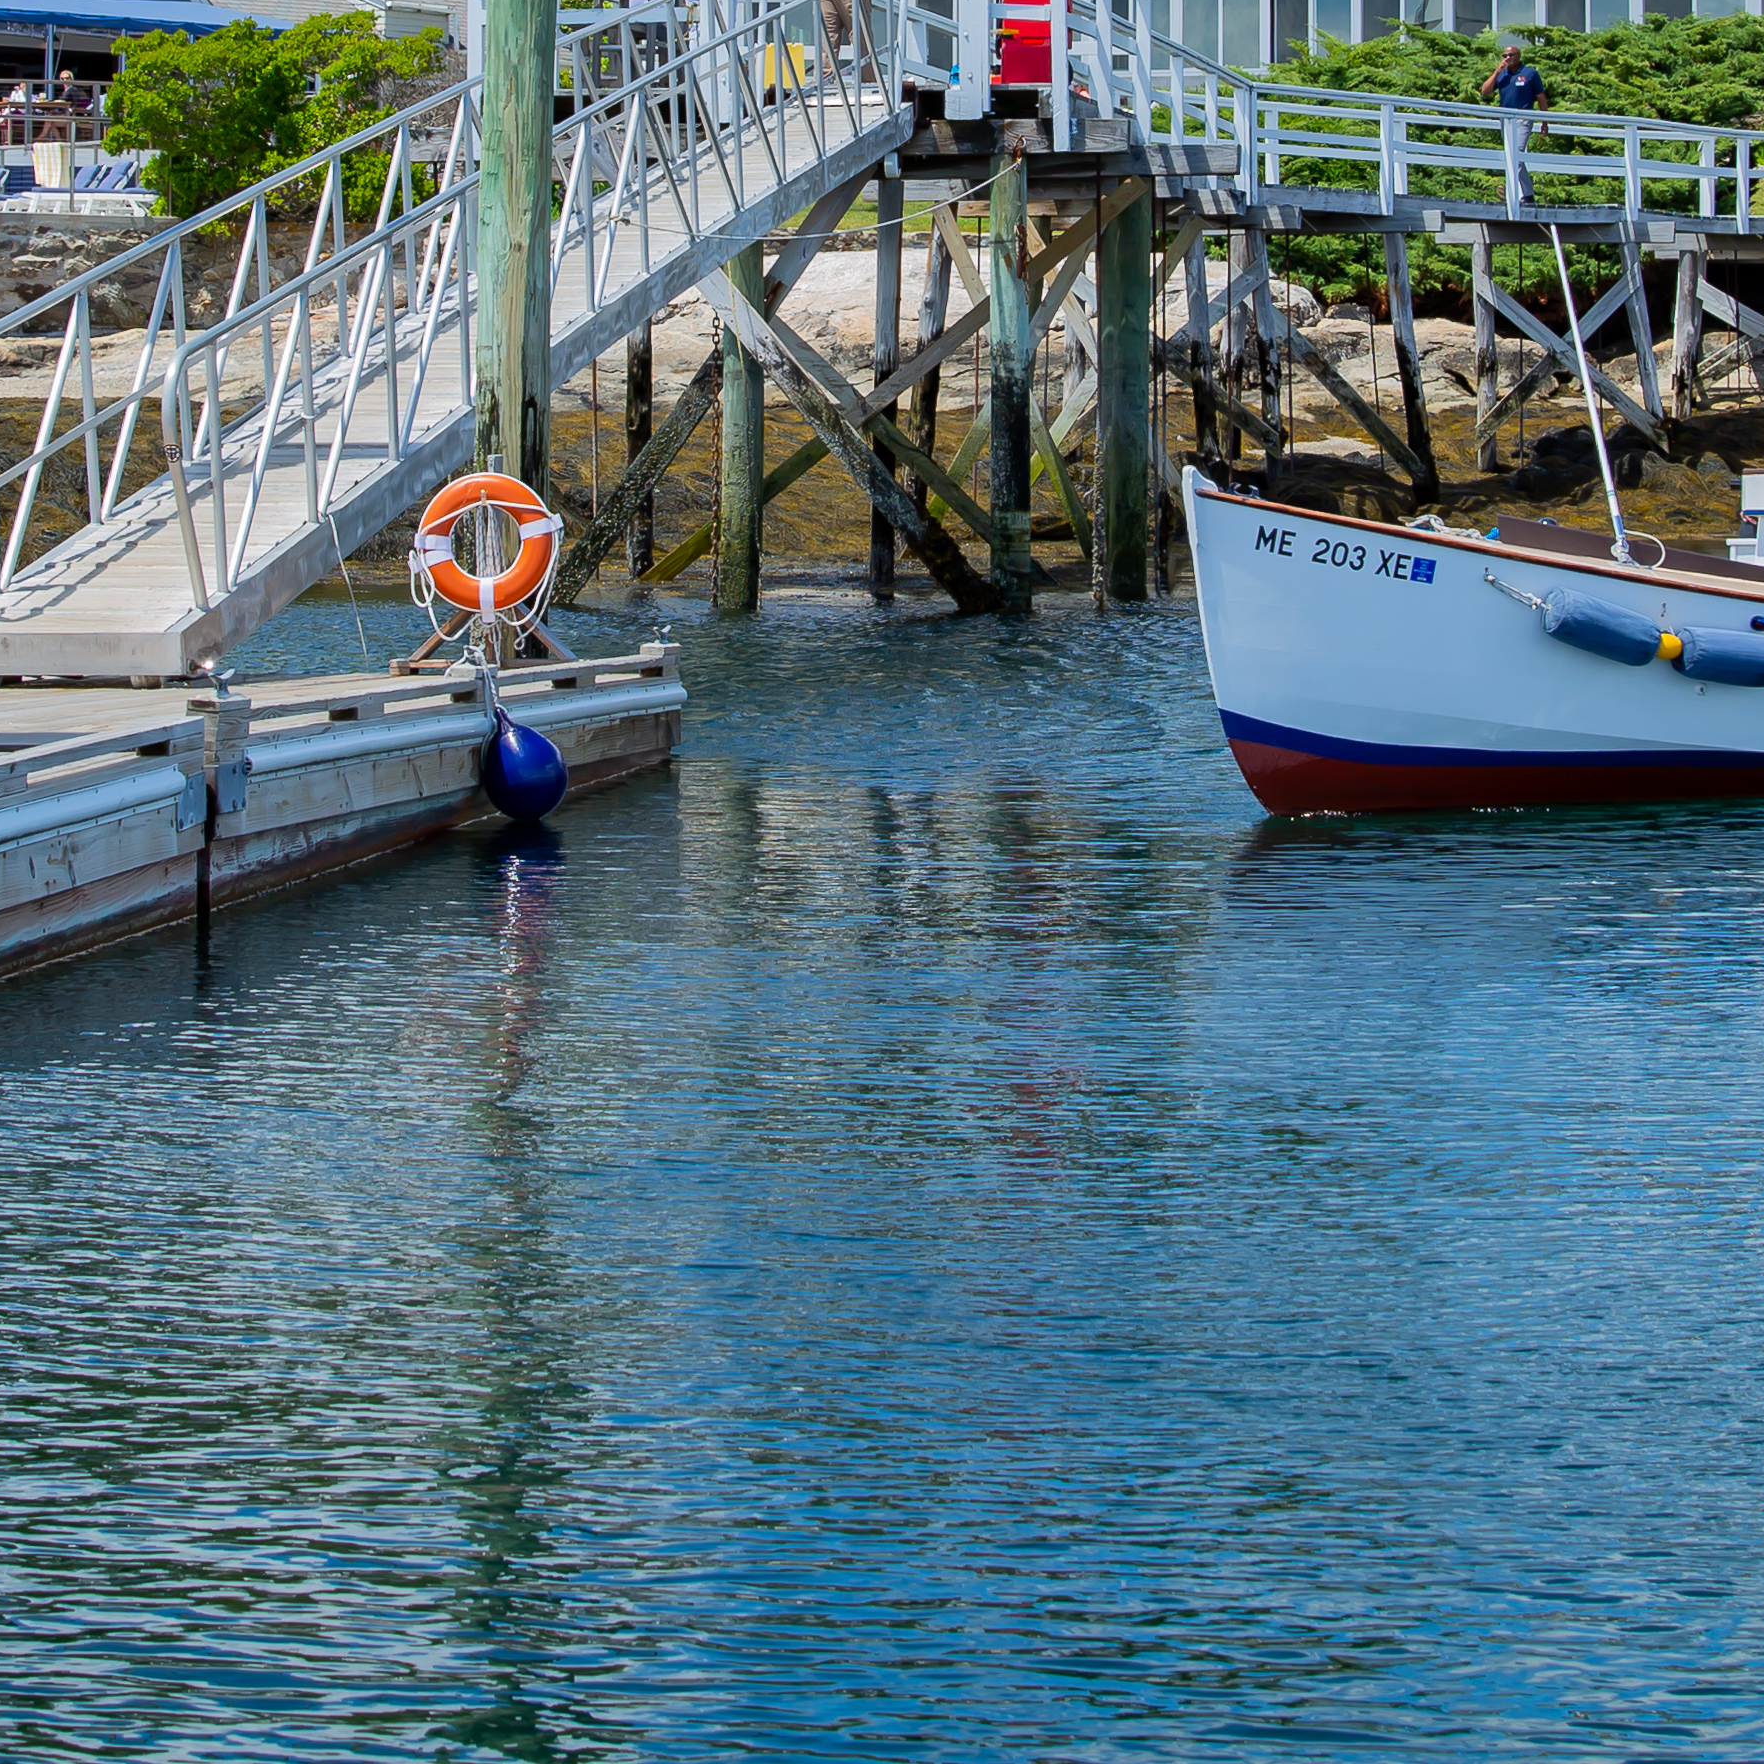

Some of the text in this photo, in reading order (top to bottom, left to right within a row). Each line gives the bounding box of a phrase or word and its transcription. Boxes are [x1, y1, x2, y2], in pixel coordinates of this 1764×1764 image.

[1254, 525, 1297, 557] ME
[1311, 538, 1367, 571] 203
[1374, 549, 1412, 580] XE
